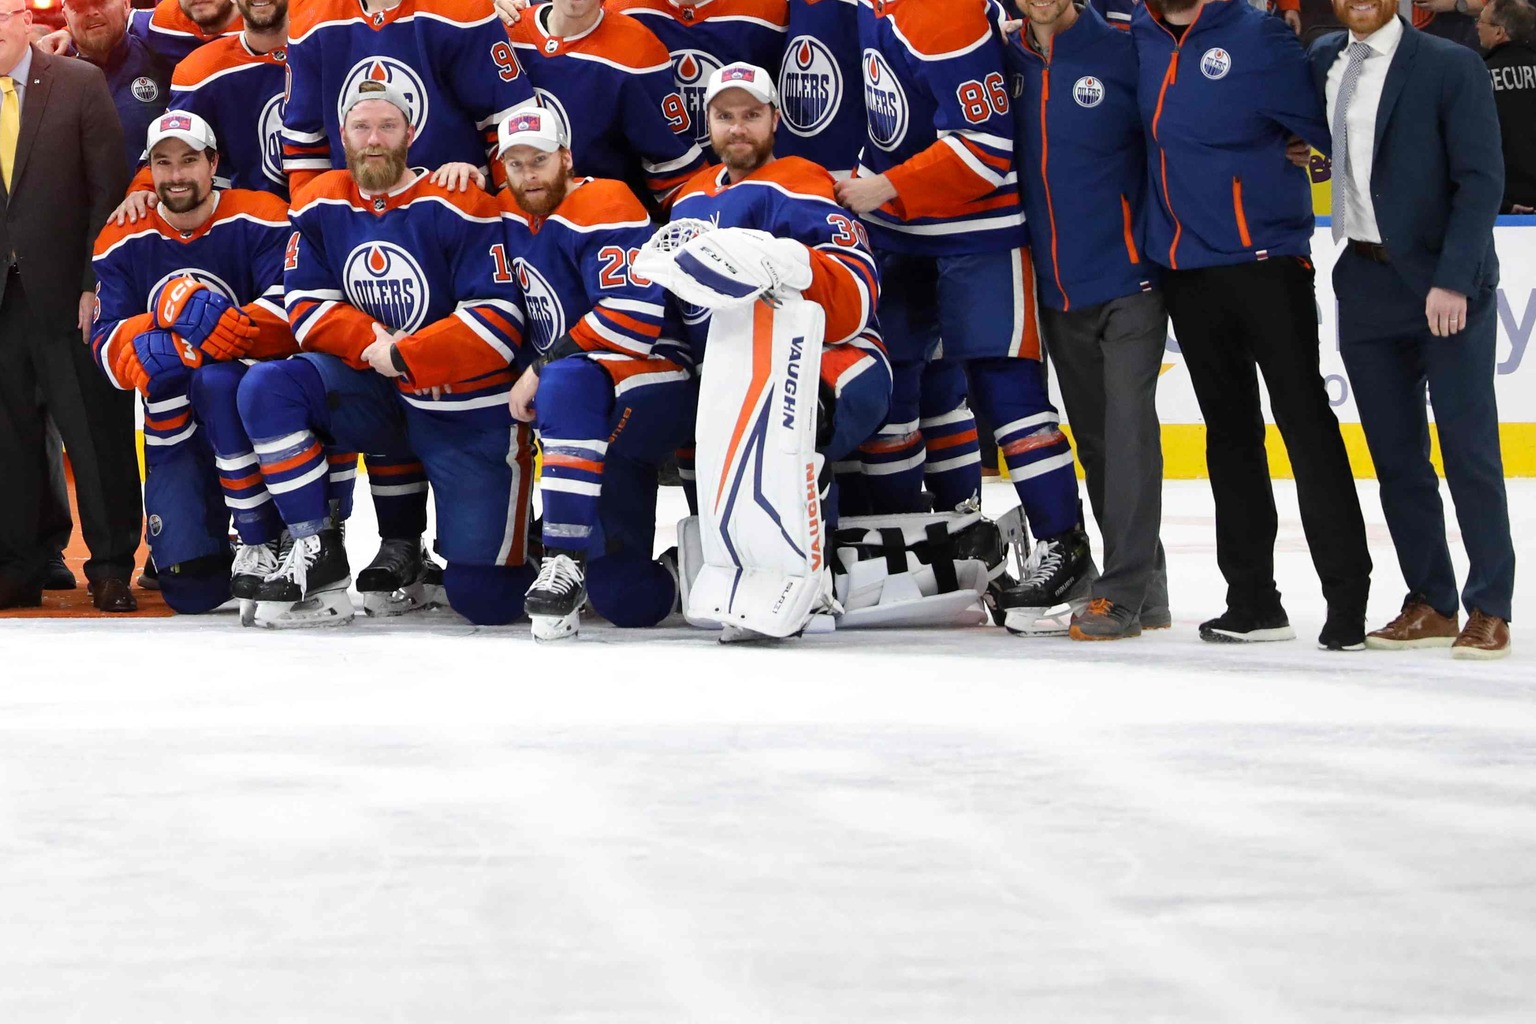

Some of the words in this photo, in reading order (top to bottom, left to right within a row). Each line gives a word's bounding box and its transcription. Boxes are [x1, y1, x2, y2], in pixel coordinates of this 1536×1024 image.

[490, 40, 520, 82] 9
[1203, 56, 1228, 73] OILERS
[785, 72, 830, 123] OILERS
[957, 72, 1010, 124] 86
[1078, 85, 1102, 104] OILERS
[353, 278, 415, 318] OILERS
[782, 335, 806, 431] VAUGHN
[807, 462, 822, 572] VAUGHN
